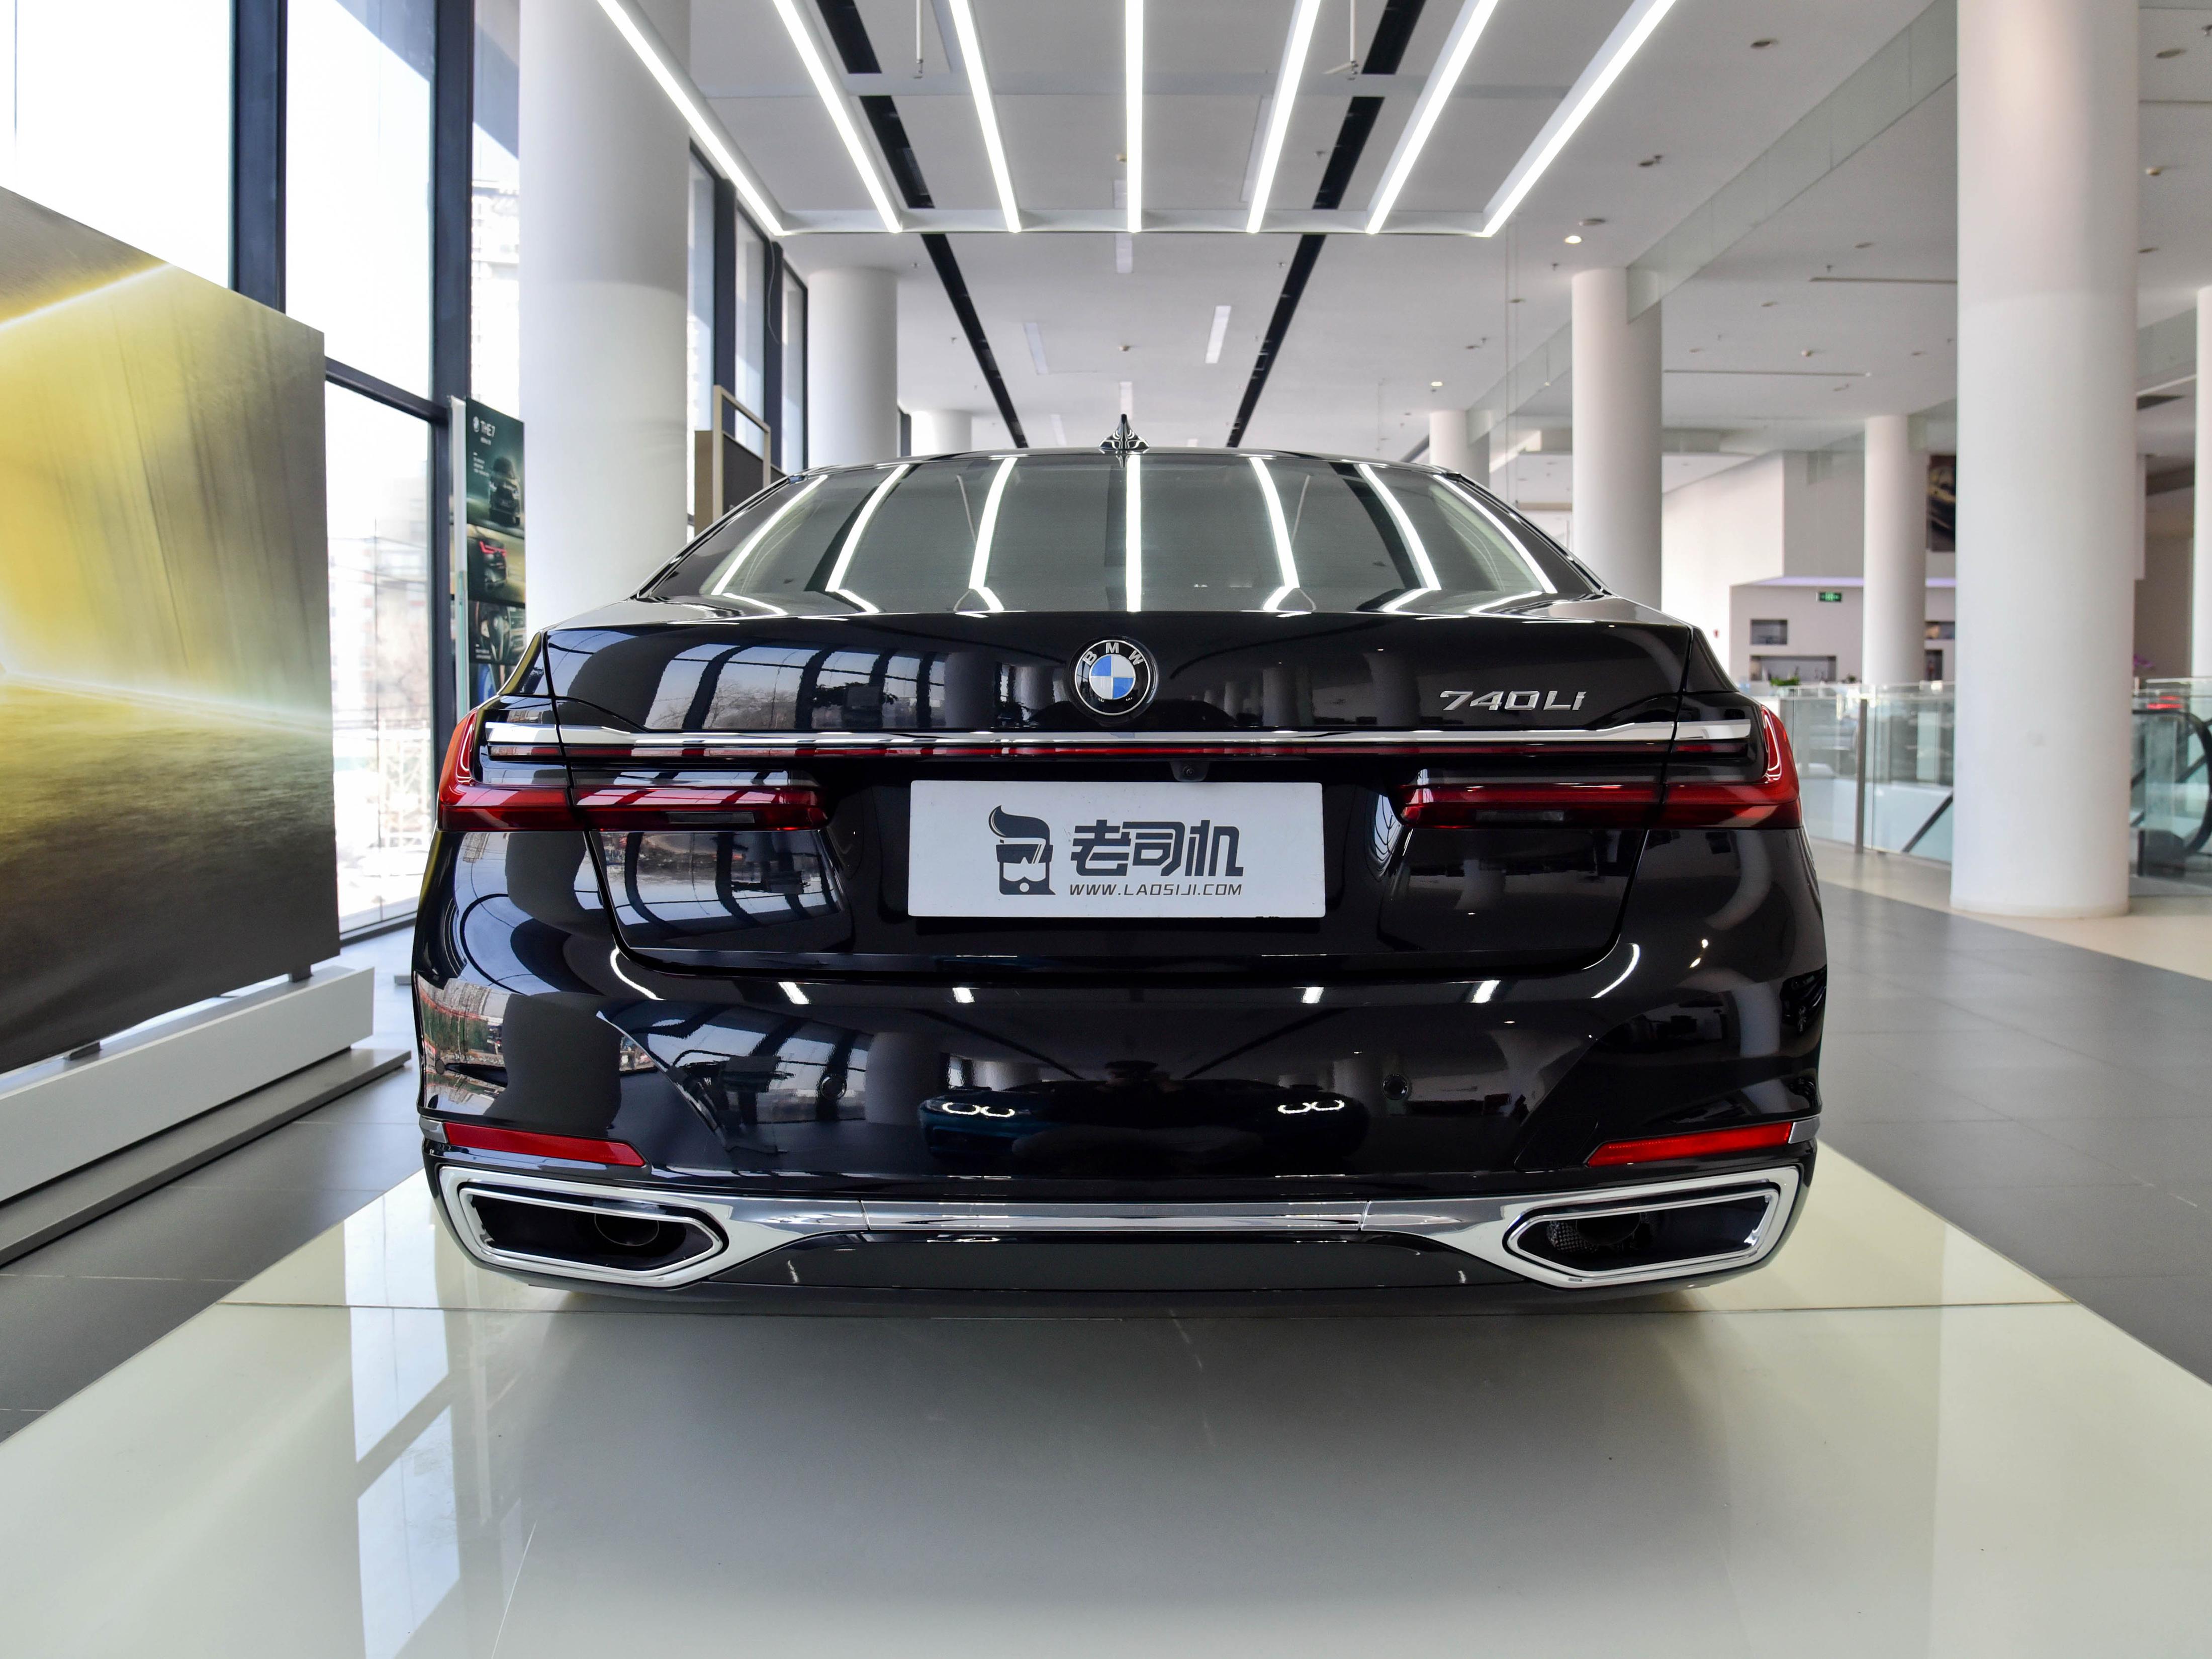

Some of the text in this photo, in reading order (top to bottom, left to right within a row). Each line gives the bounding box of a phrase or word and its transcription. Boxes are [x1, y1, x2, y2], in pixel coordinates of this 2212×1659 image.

[1082, 642, 1144, 666] BMW
[1440, 691, 1587, 710] 740Li
[1070, 819, 1244, 876] 老司机
[1070, 884, 1242, 895] WWW.LAOSIJI.COM
